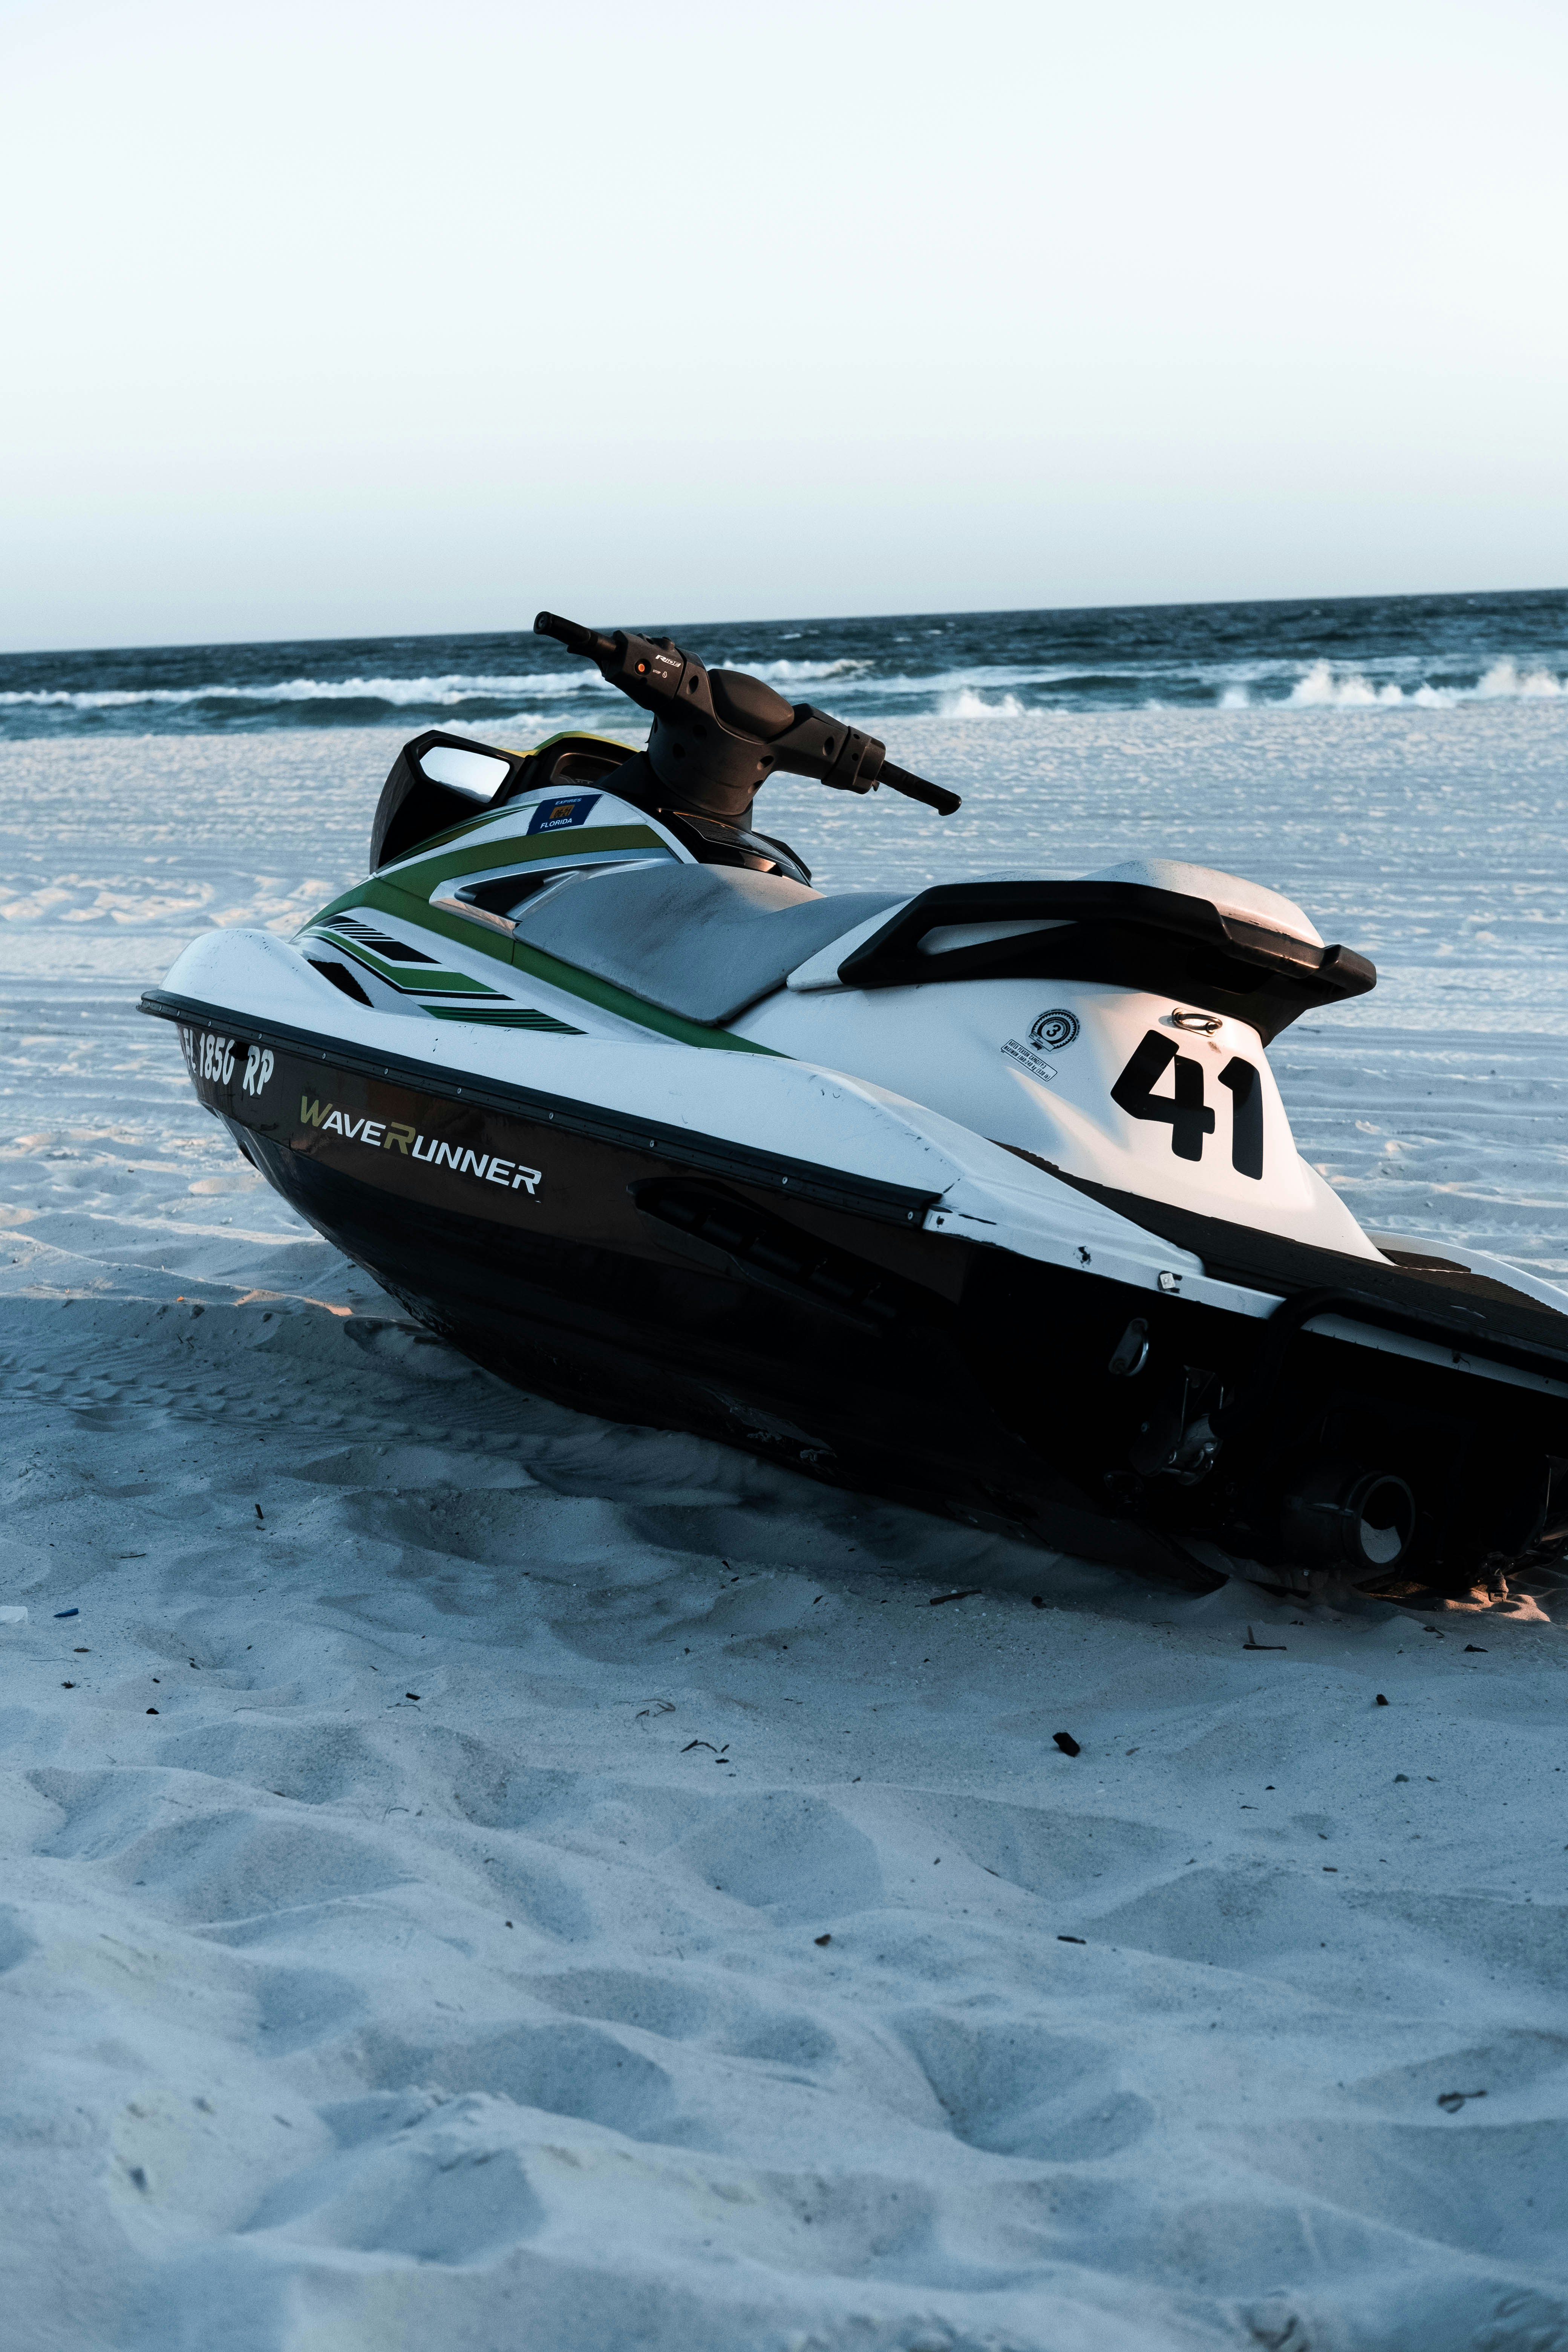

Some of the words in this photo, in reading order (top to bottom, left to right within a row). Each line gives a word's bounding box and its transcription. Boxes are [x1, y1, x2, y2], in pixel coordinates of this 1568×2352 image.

[540, 818, 572, 829] FLORIDA
[1046, 1024, 1061, 1037] 3
[1003, 1045, 1019, 1057] MAXIMUM
[1008, 1041, 1018, 1050] RATED
[1017, 1047, 1031, 1058] PERSON
[200, 1032, 235, 1085] 1850
[242, 1044, 274, 1096] RP
[1110, 1029, 1263, 1180] 41
